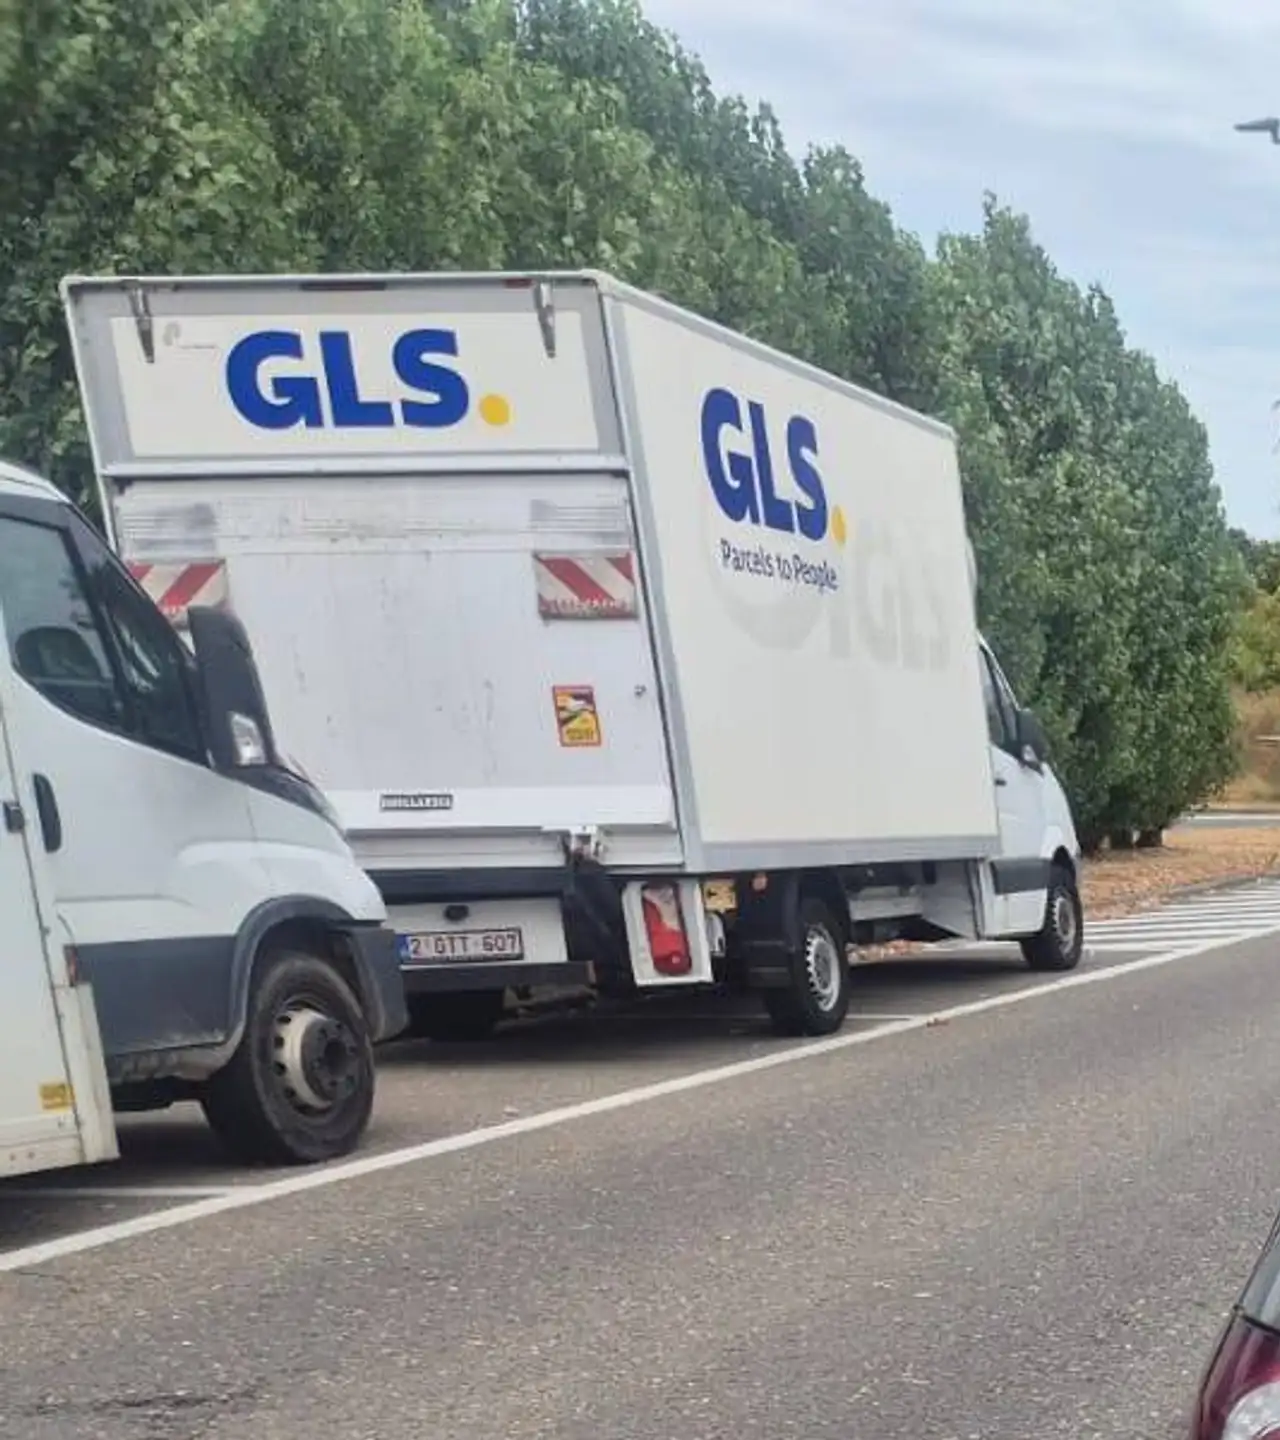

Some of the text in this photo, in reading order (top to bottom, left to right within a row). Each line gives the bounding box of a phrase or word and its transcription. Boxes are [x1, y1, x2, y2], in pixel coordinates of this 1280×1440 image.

[719, 537, 839, 596] Parcels to People
